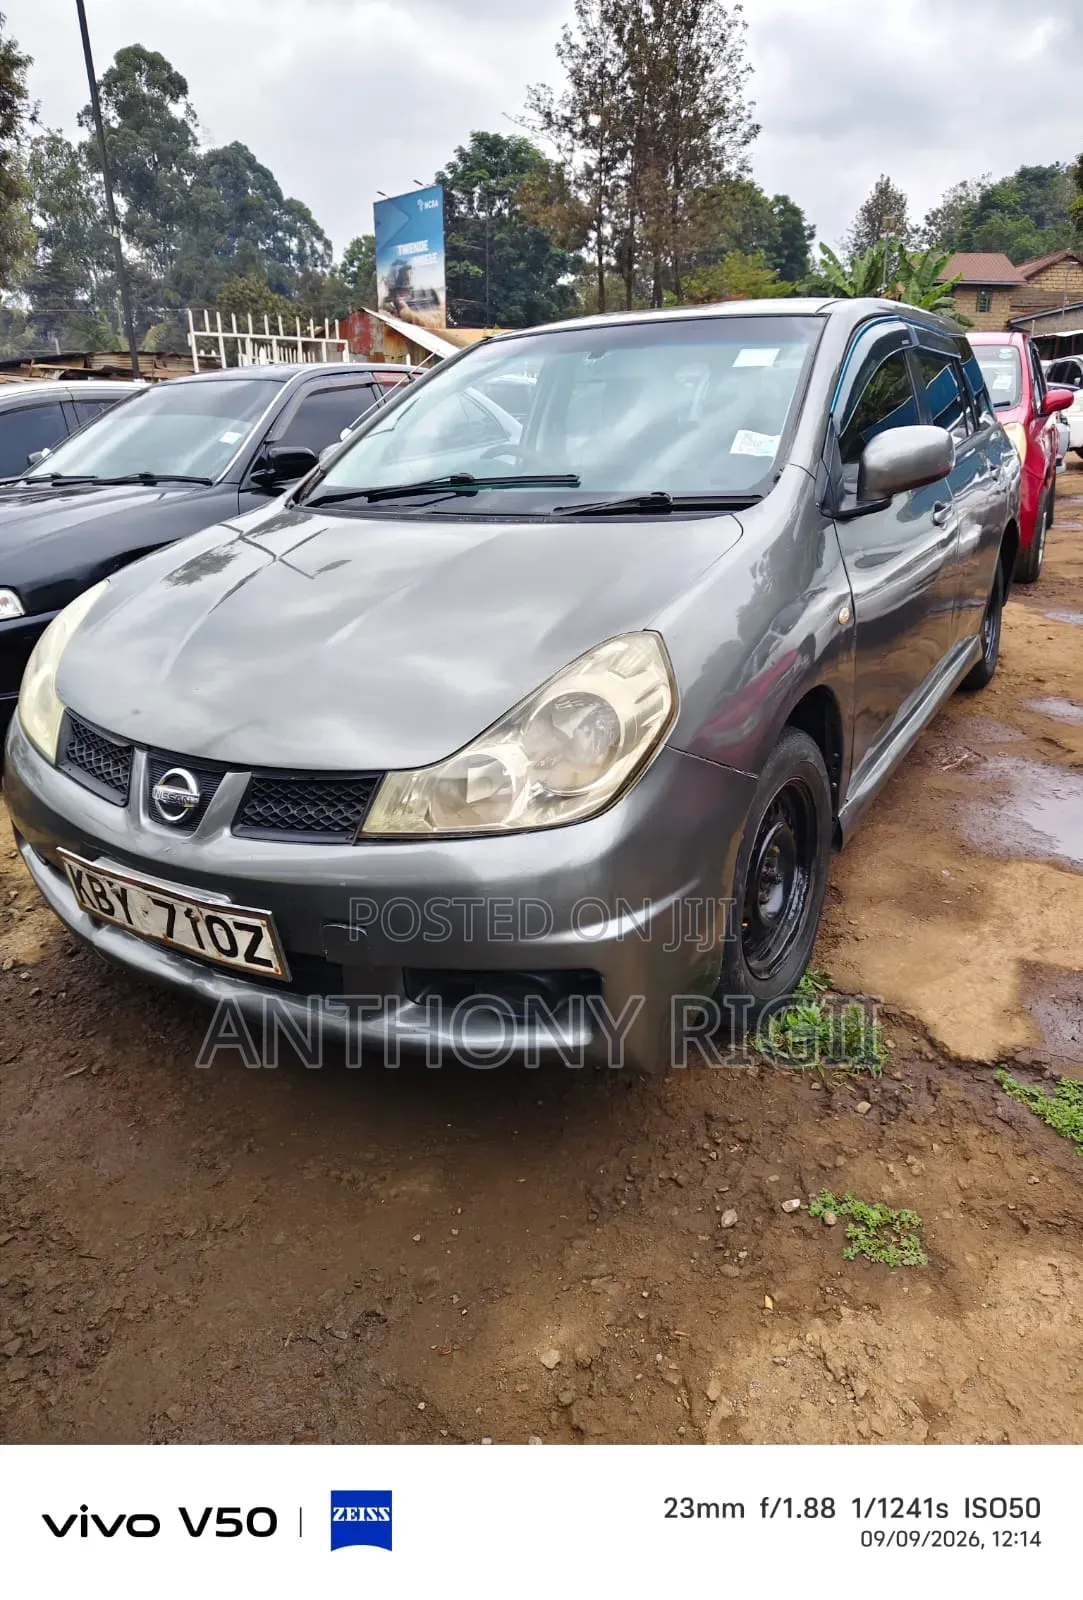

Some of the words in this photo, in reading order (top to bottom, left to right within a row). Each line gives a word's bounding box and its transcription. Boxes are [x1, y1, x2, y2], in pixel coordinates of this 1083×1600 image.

[153, 788, 193, 806] NISSAN
[67, 864, 134, 926] KBY
[149, 895, 274, 969] 710Z
